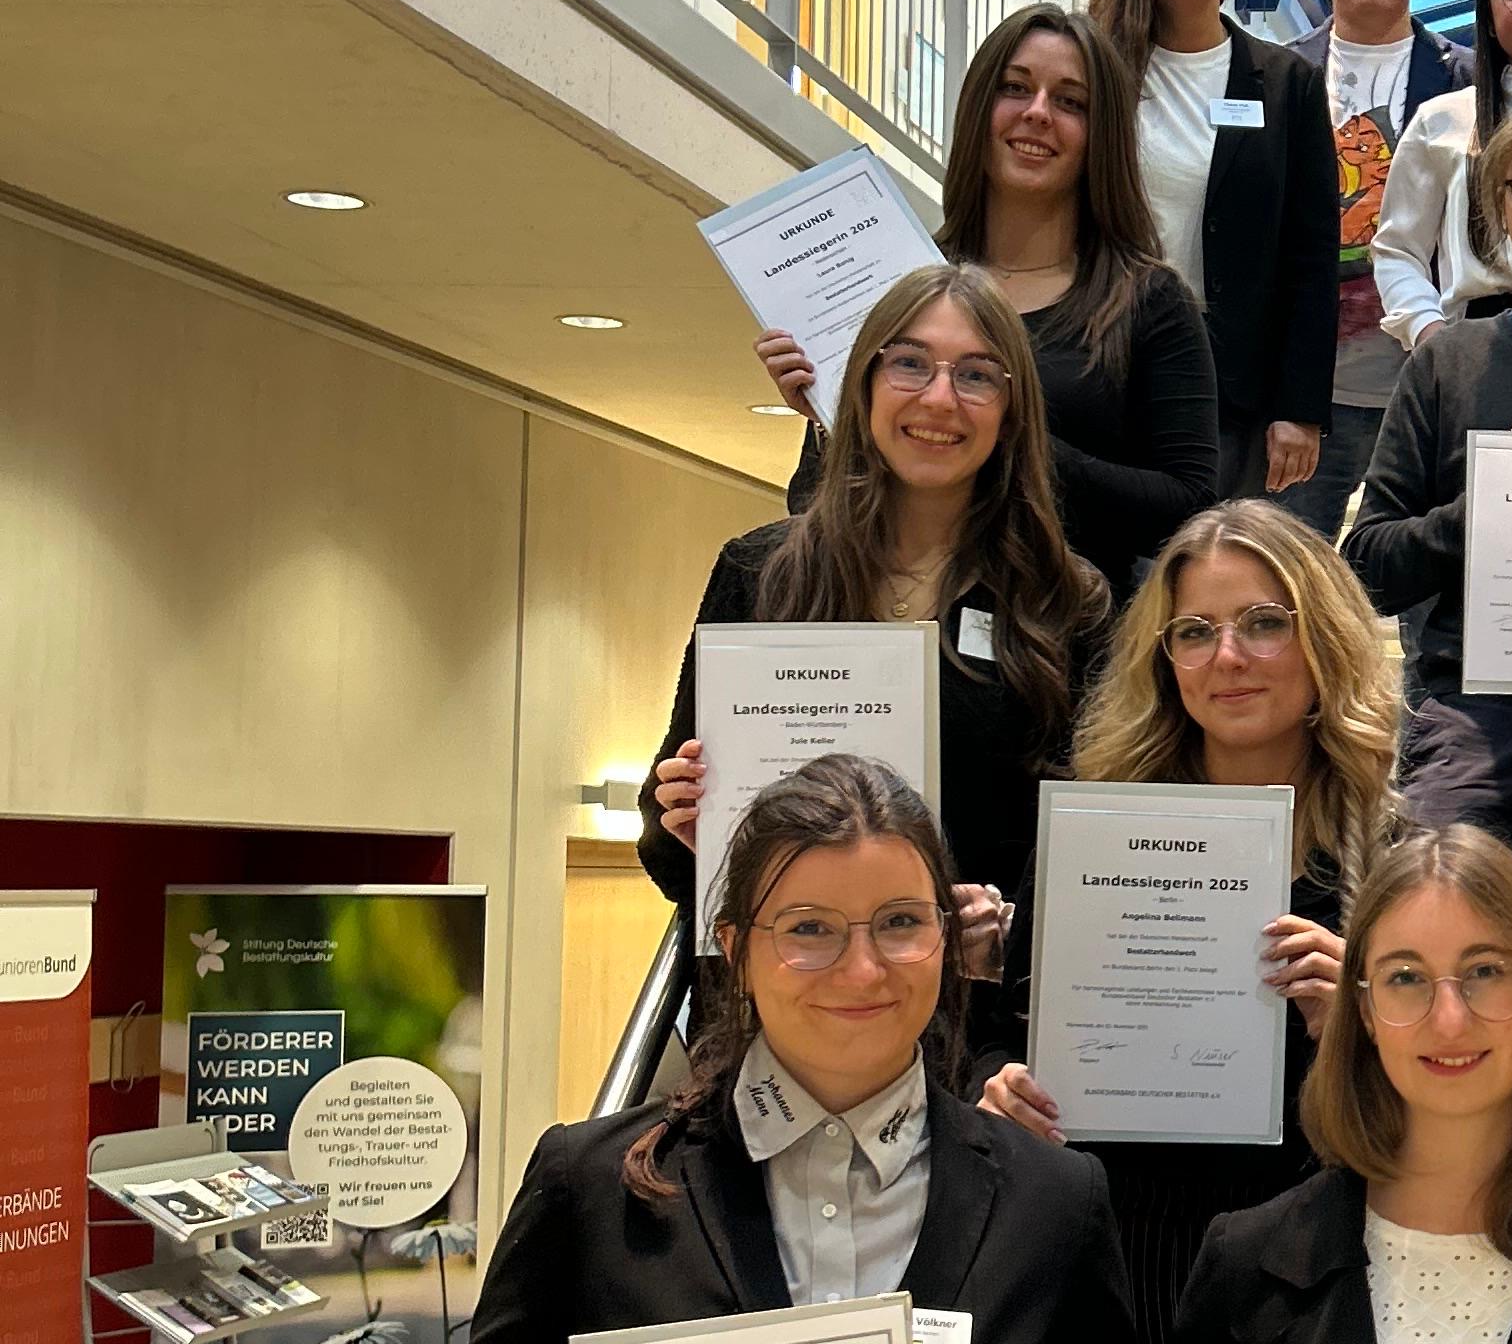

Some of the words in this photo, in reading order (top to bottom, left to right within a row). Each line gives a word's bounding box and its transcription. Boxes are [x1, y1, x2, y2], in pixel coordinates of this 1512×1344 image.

[778, 208, 835, 240] URKUNDE
[763, 232, 848, 277] Landessiegerin
[849, 215, 878, 234] 2025
[775, 669, 850, 680] URKUNDE
[733, 702, 848, 716] Landessiegerin
[854, 703, 891, 713] 2025
[1128, 838, 1207, 852] URKUNDE
[1082, 873, 1202, 890] Landessiegerin
[1209, 878, 1248, 890] 2025
[243, 939, 284, 951] Stiftung
[287, 938, 339, 950] Deutsche
[243, 952, 334, 964] Bestattungskultur
[198, 1028, 334, 1051] FÖRDERER
[197, 1058, 309, 1078] WERDEN
[350, 1080, 410, 1093] Begleiten
[196, 1086, 268, 1106] KANN
[325, 1096, 350, 1107] und
[354, 1095, 412, 1108] gestalten
[415, 1093, 434, 1105] Sie
[761, 1074, 795, 1123] Johannes
[195, 1113, 276, 1133] DER
[316, 1111, 338, 1122] mit
[341, 1112, 364, 1122] uns
[367, 1109, 442, 1123] gemeinsam
[304, 1127, 329, 1138] den
[332, 1125, 381, 1137] Wandel
[383, 1125, 405, 1136] der
[408, 1124, 453, 1134] Bestat-
[365, 1140, 410, 1151] Trauer-
[413, 1138, 438, 1150] und
[328, 1154, 428, 1168] Friedhofskultur.
[338, 1181, 360, 1192] Wir
[365, 1181, 407, 1192] freuen
[410, 1180, 433, 1191] uns
[338, 1196, 359, 1207] auf
[361, 1195, 384, 1206] Sie!
[0, 1220, 69, 1253] NUNGEN
[916, 1317, 957, 1329] Völkner
